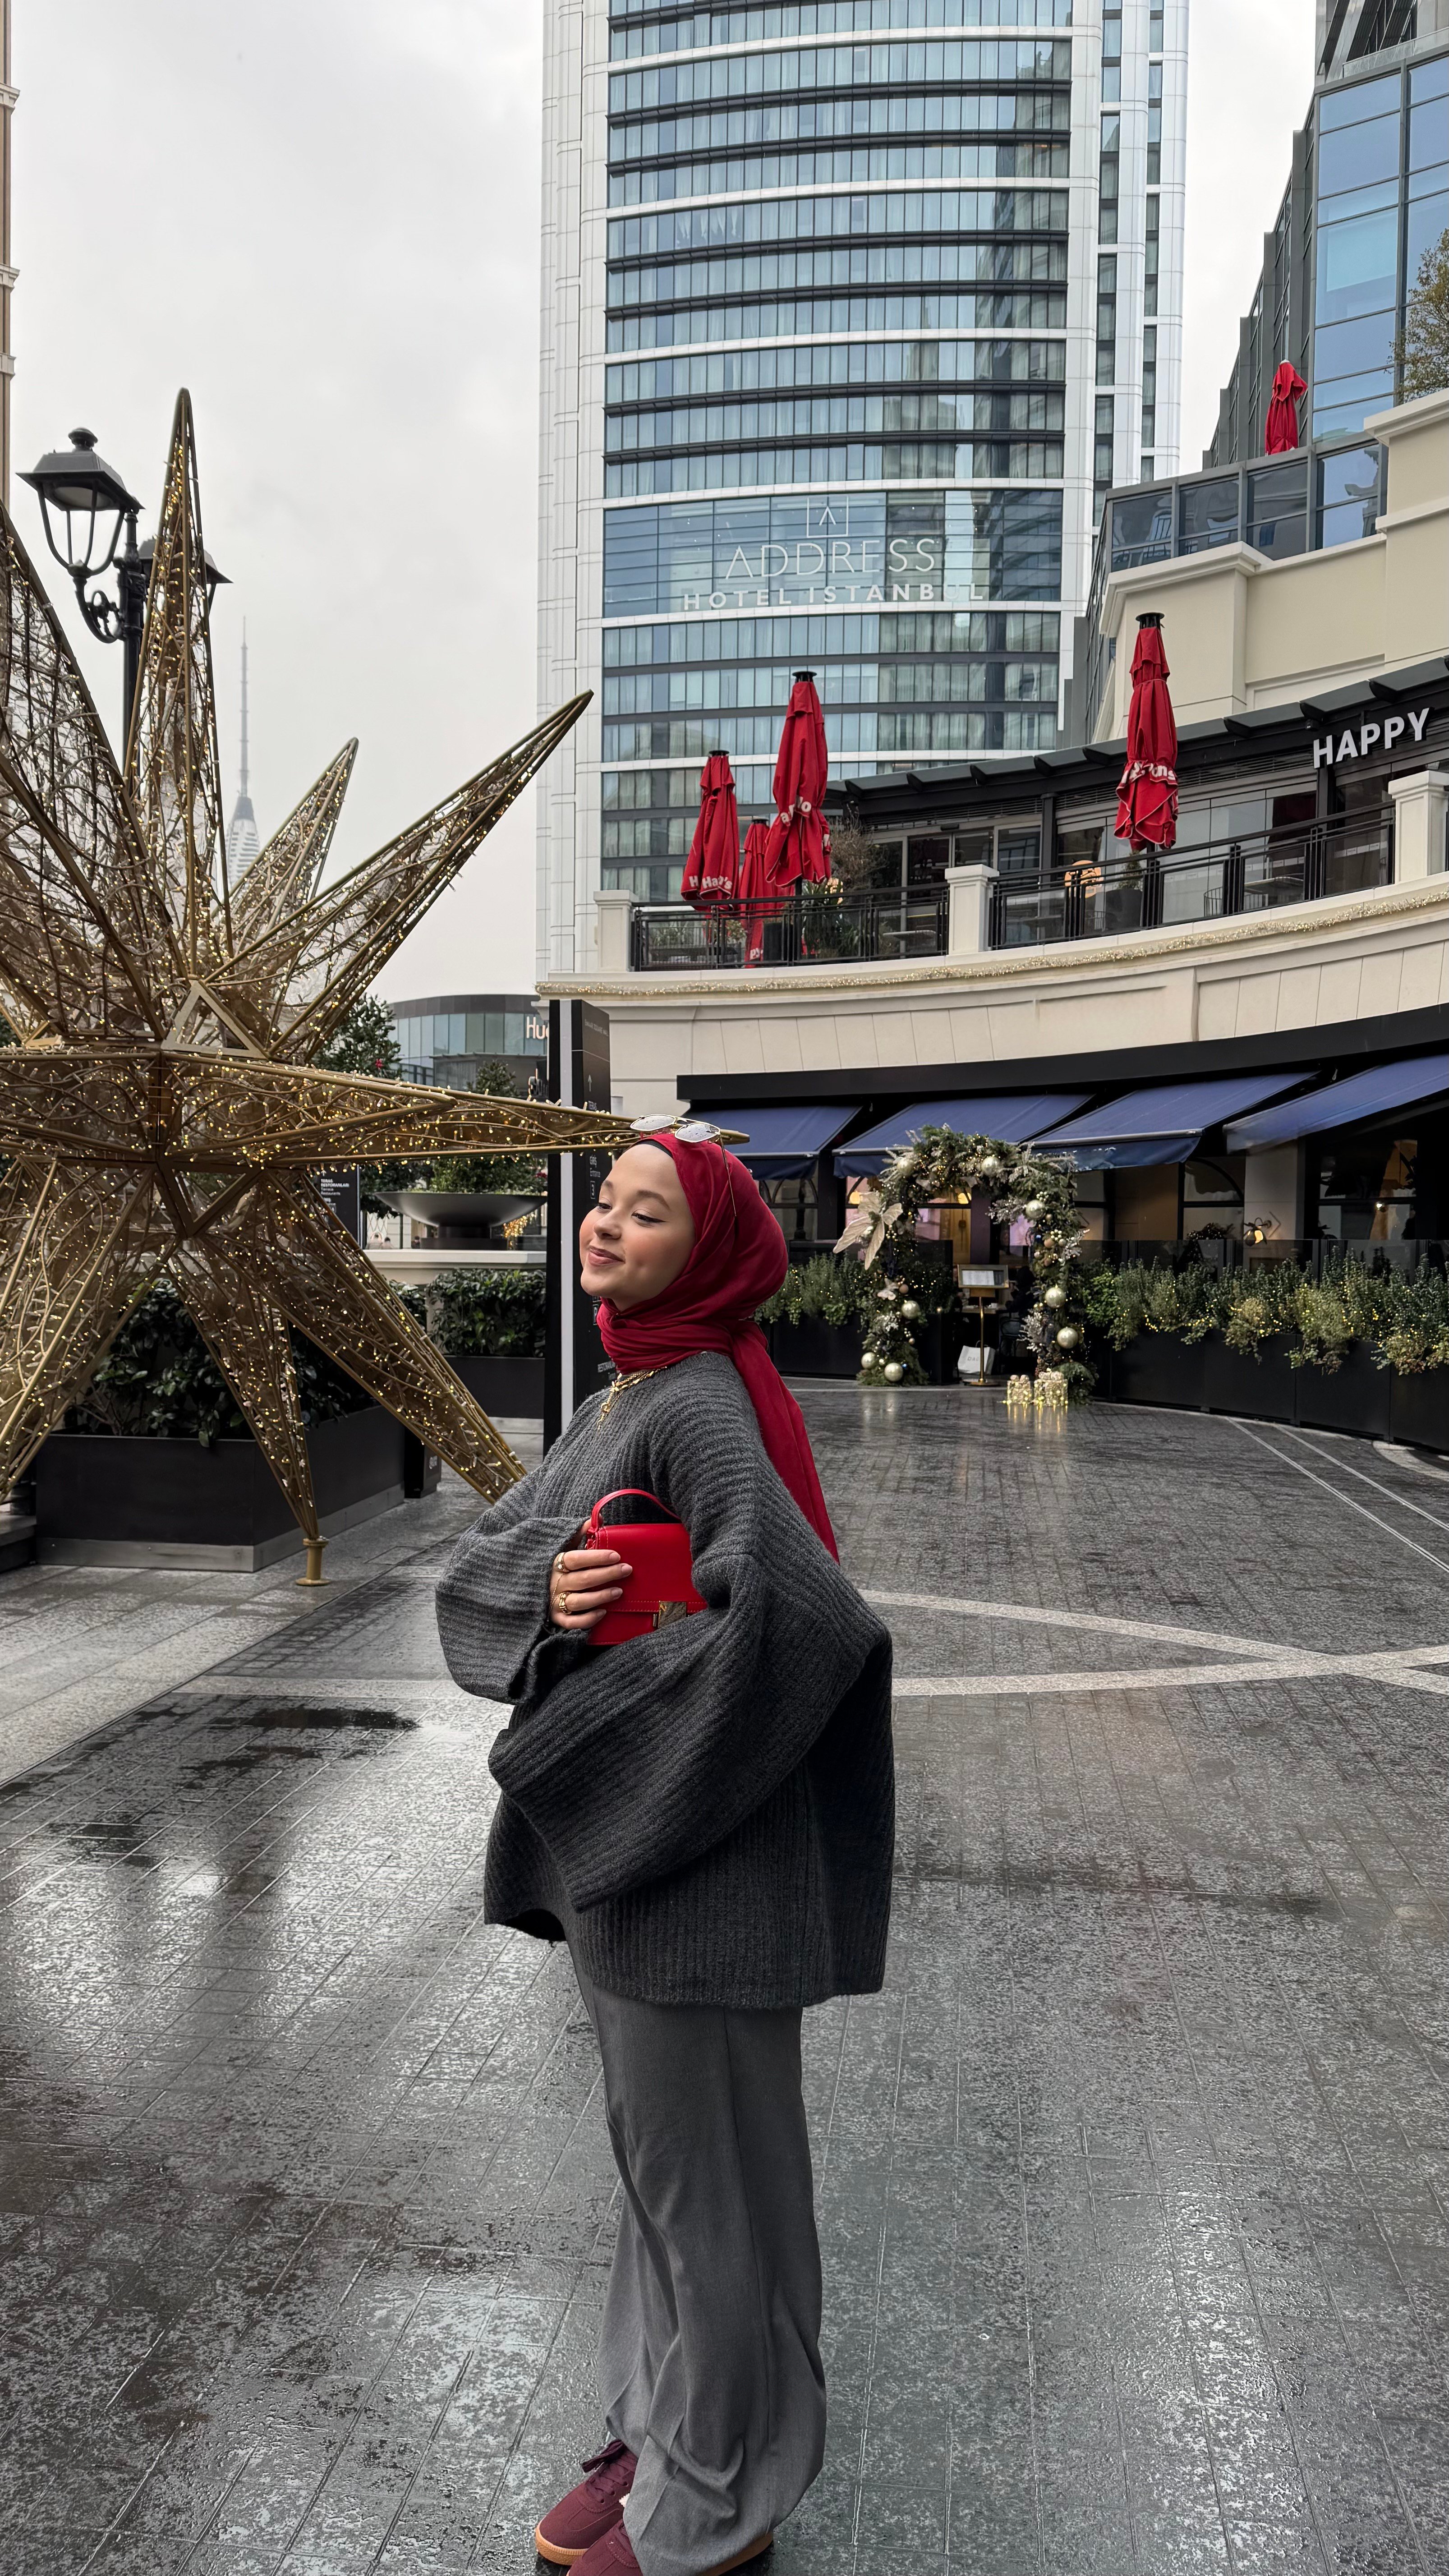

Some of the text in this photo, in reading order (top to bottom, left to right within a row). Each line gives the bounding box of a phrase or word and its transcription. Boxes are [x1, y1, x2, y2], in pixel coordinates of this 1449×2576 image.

[726, 538, 936, 580] ADDRESS
[684, 583, 983, 611] HOTEL ISTANBUL
[1313, 707, 1432, 769] HAPPY
